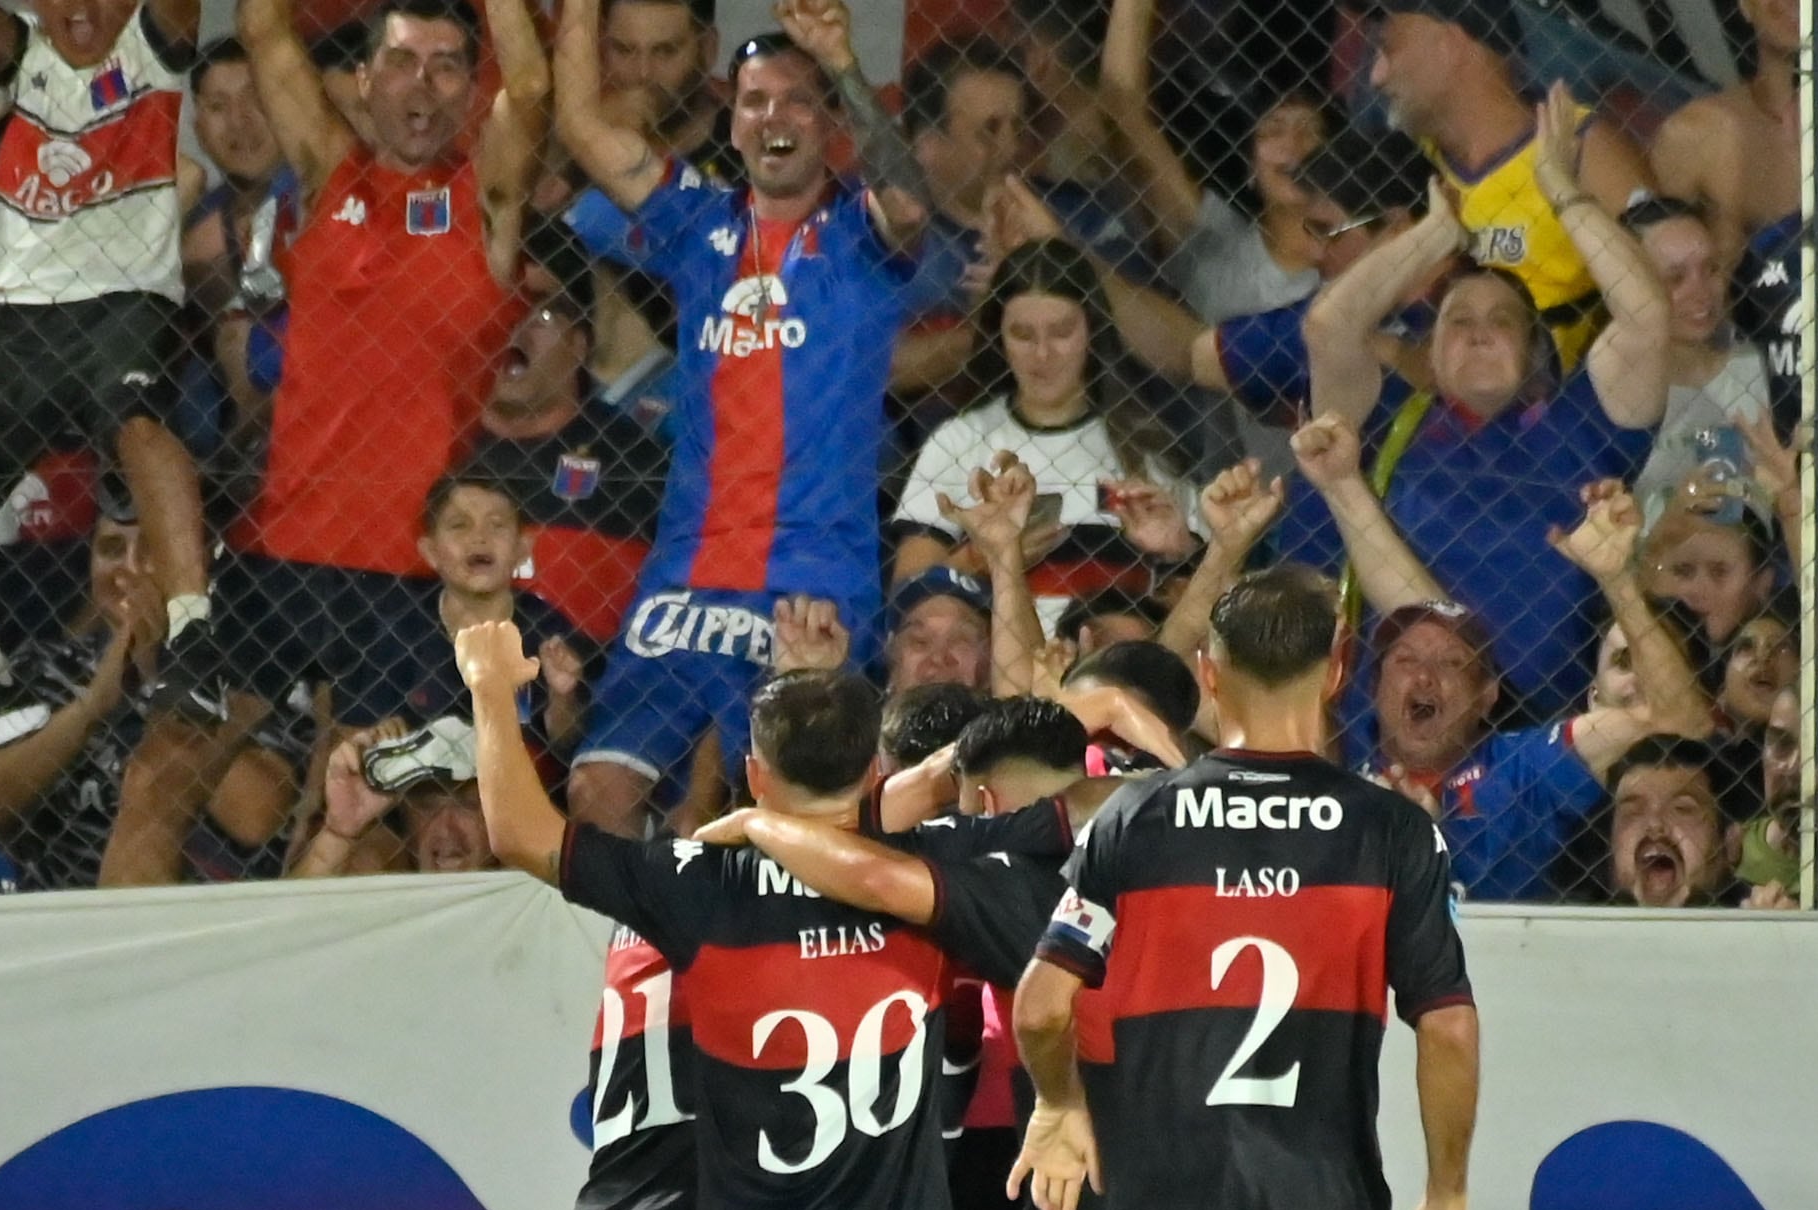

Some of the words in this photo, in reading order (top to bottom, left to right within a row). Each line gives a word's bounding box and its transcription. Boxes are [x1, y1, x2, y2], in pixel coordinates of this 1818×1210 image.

[699, 316, 807, 358] Maro
[625, 591, 774, 666] CLIPPE
[1174, 787, 1344, 831] Macro
[1215, 866, 1301, 898] LASO
[797, 921, 887, 960] ELIAS
[1205, 935, 1302, 1108] 2
[592, 968, 698, 1153] 21
[751, 989, 929, 1175] 30
